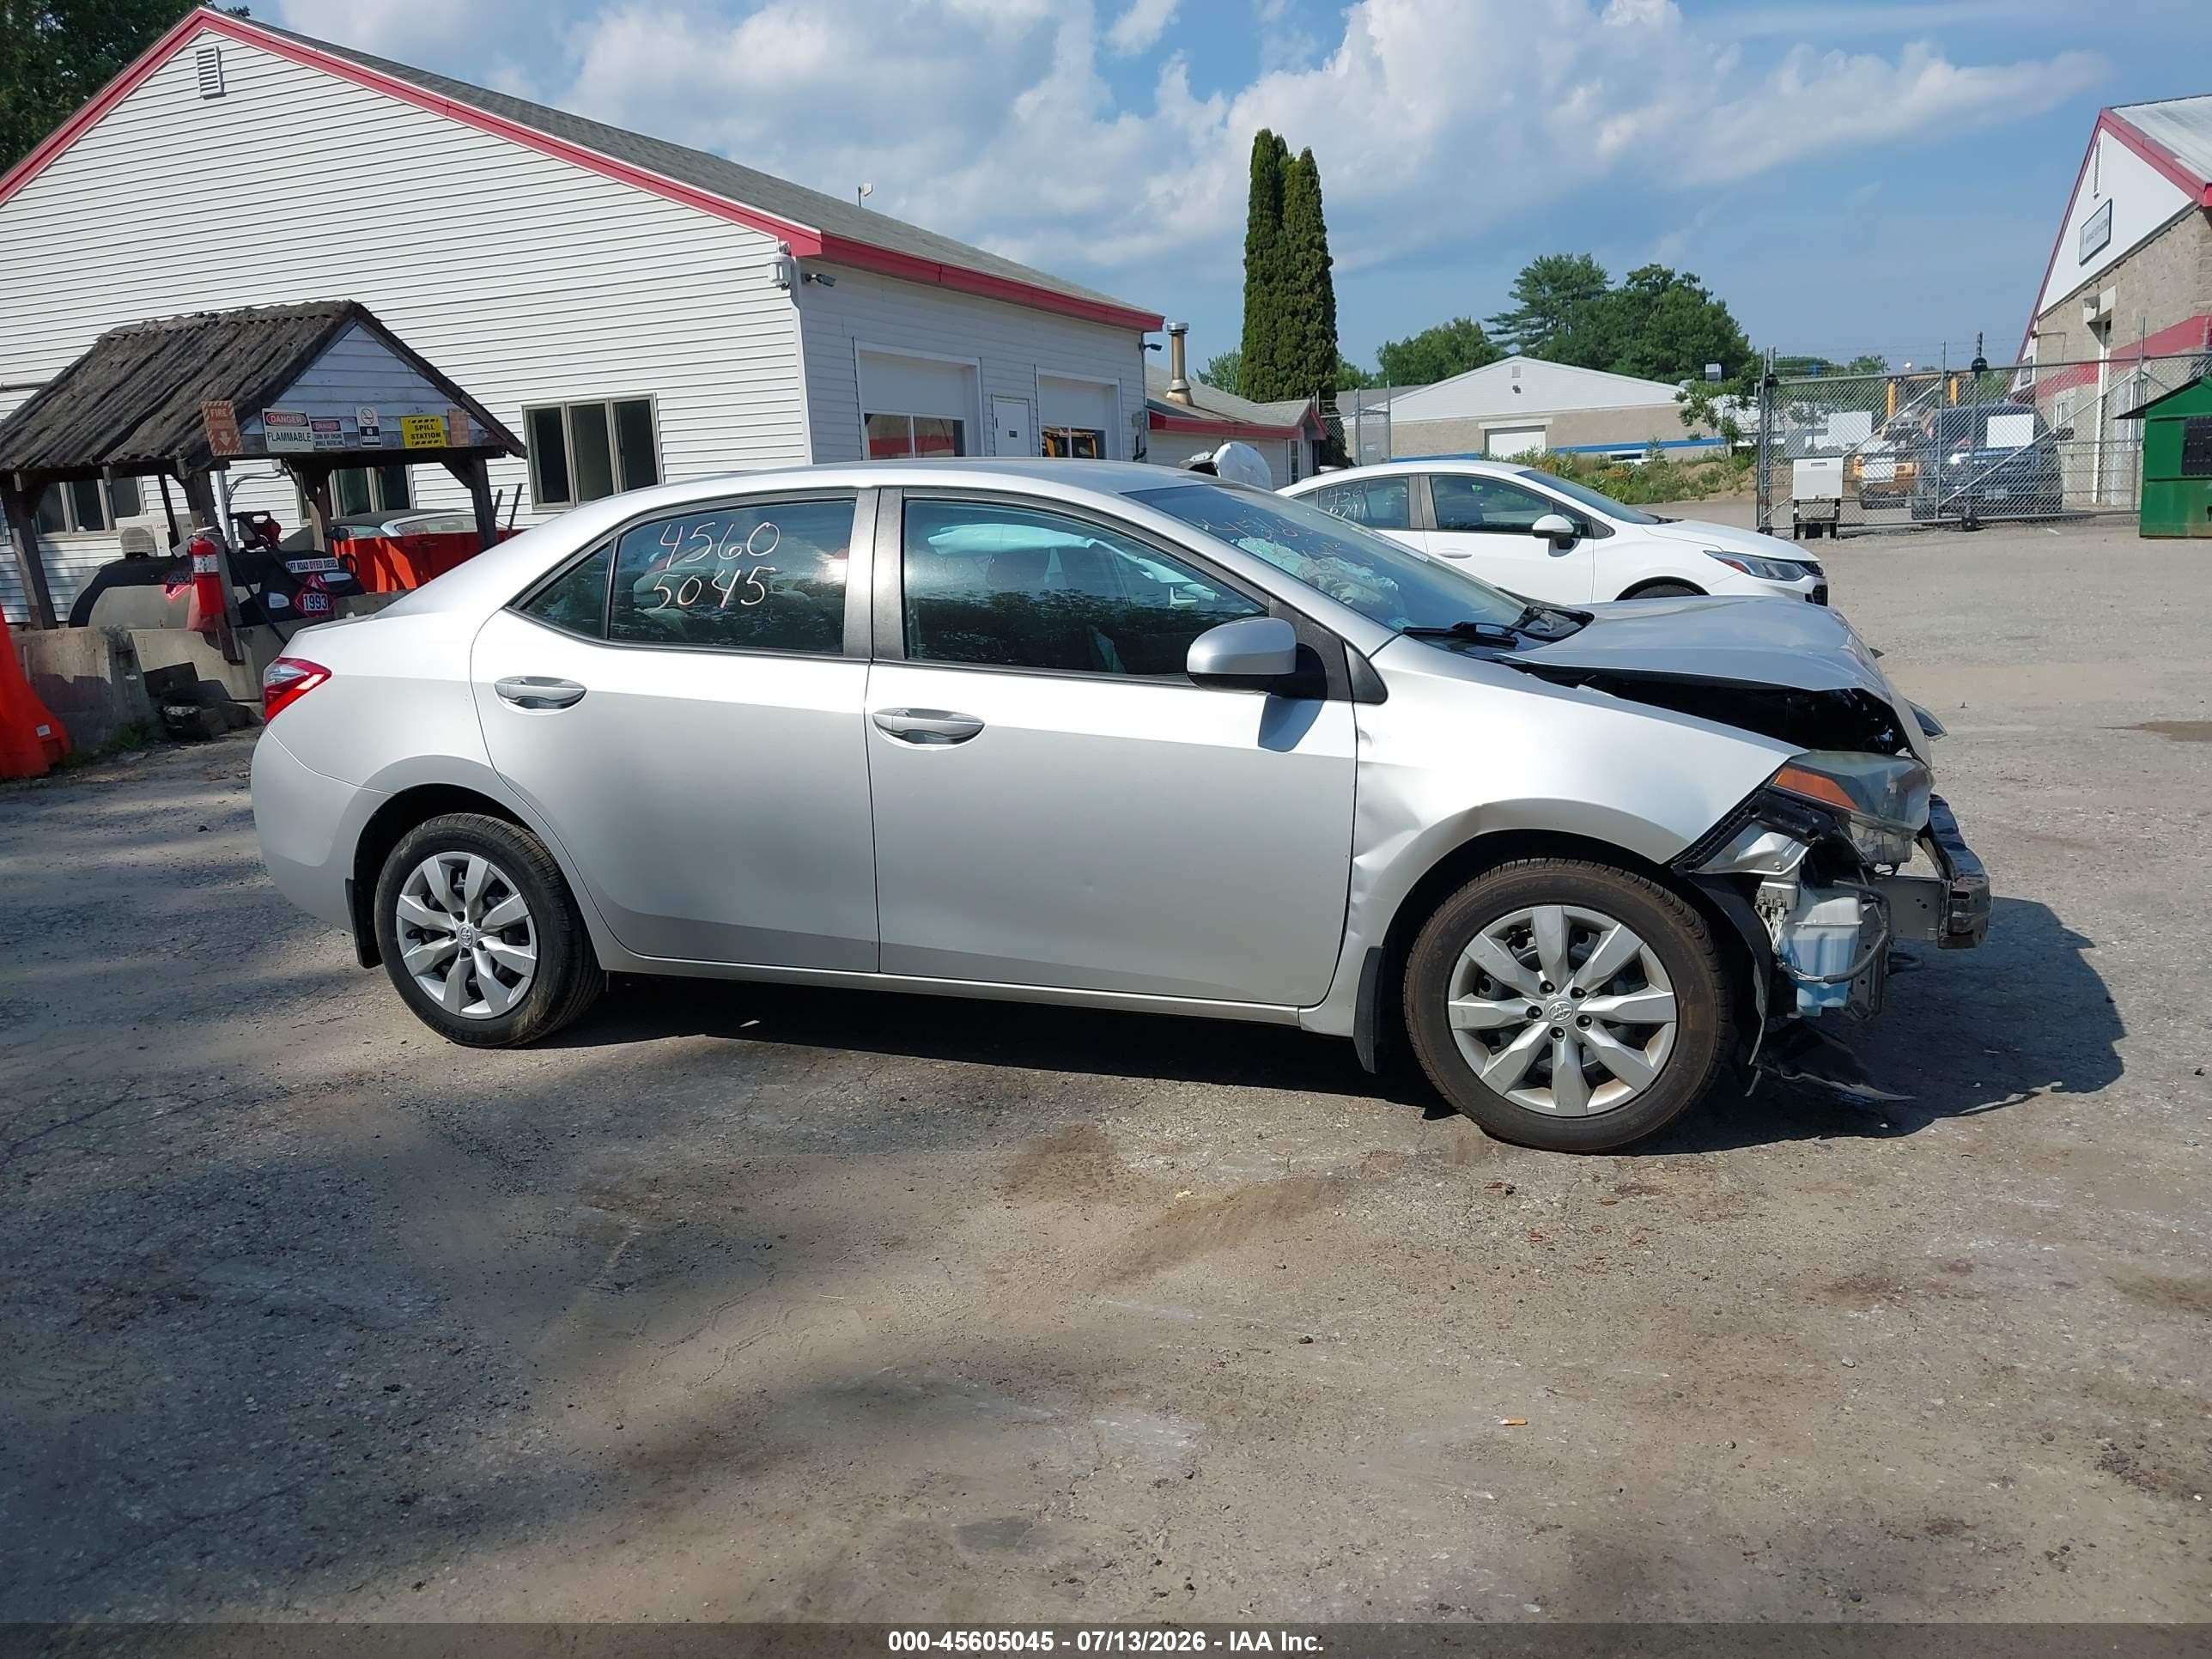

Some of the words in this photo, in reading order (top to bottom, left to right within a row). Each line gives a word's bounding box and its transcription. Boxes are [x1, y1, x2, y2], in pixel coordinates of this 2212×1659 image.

[210, 408, 228, 417] FIRE
[270, 415, 303, 424] DANGER
[267, 431, 312, 442] FLAMMABLE
[659, 521, 781, 570] 4560
[287, 562, 296, 571] OFF
[296, 561, 309, 570] ROAD
[309, 560, 323, 569] DYED
[648, 565, 777, 613] 5045
[303, 594, 327, 610] 1993
